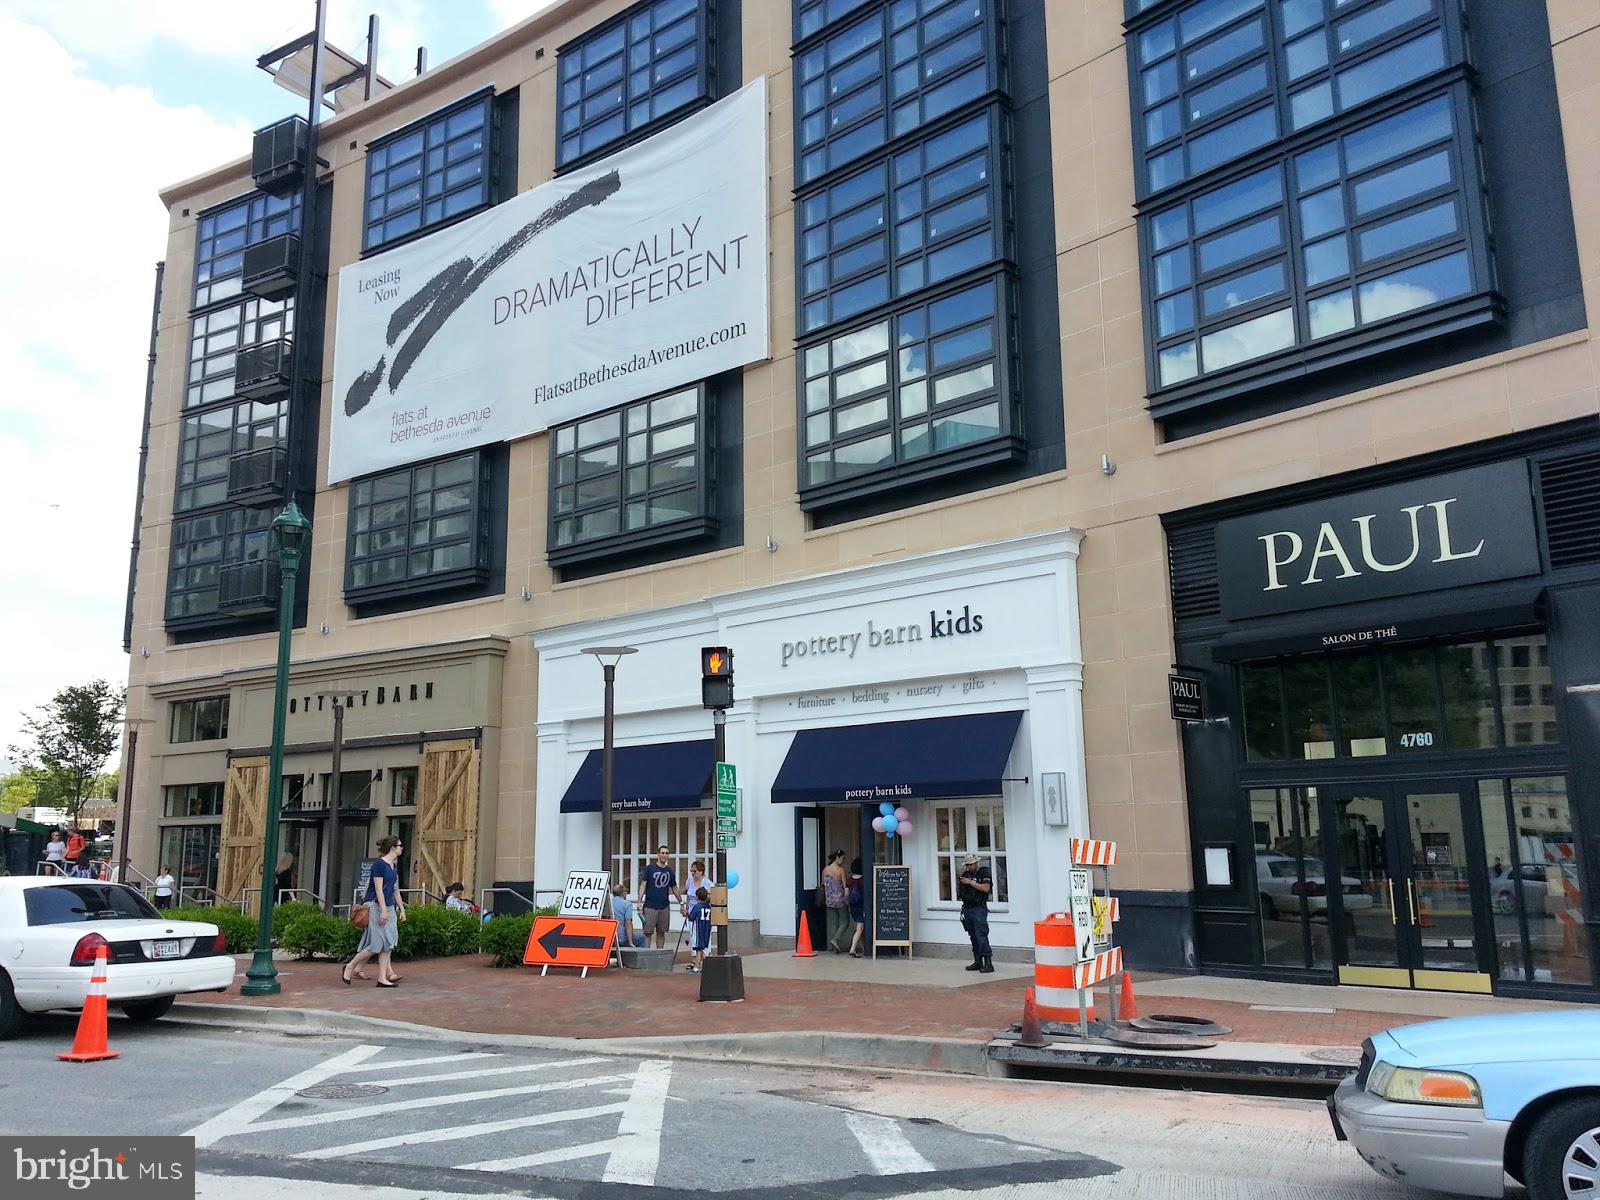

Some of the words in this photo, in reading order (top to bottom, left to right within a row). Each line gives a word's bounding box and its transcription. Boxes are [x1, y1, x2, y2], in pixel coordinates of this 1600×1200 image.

[493, 216, 702, 325] DRAMATICALLY
[586, 234, 749, 326] DIFFERENT
[358, 268, 401, 293] Leasing
[374, 286, 400, 304] Now
[533, 321, 747, 405] FlatsatBethesdaAvenue.com
[390, 418, 443, 444] bethesda
[446, 407, 491, 429] avenue
[391, 411, 415, 427] flats
[417, 405, 428, 420] at
[1257, 498, 1486, 591] PAUL
[781, 631, 862, 668] pottery
[868, 620, 923, 648] barn
[929, 605, 984, 639] kids
[1322, 632, 1357, 645] SALON
[1358, 631, 1374, 641] DE
[1374, 625, 1398, 638] THÉ
[797, 695, 837, 709] furniture
[852, 690, 890, 703] bedding
[906, 682, 943, 697] nursery
[962, 678, 985, 693] gifts
[1172, 681, 1201, 699] PAUL
[1400, 731, 1433, 748] 4760
[845, 789, 874, 800] pottery
[875, 785, 894, 796] barn
[895, 784, 912, 795] kids
[623, 798, 637, 808] barn
[637, 797, 652, 808] baby
[569, 877, 605, 891] TRAIL
[1073, 873, 1086, 889] STOP
[564, 896, 599, 910] USER
[700, 908, 711, 921] 17
[1077, 911, 1088, 927] RED
